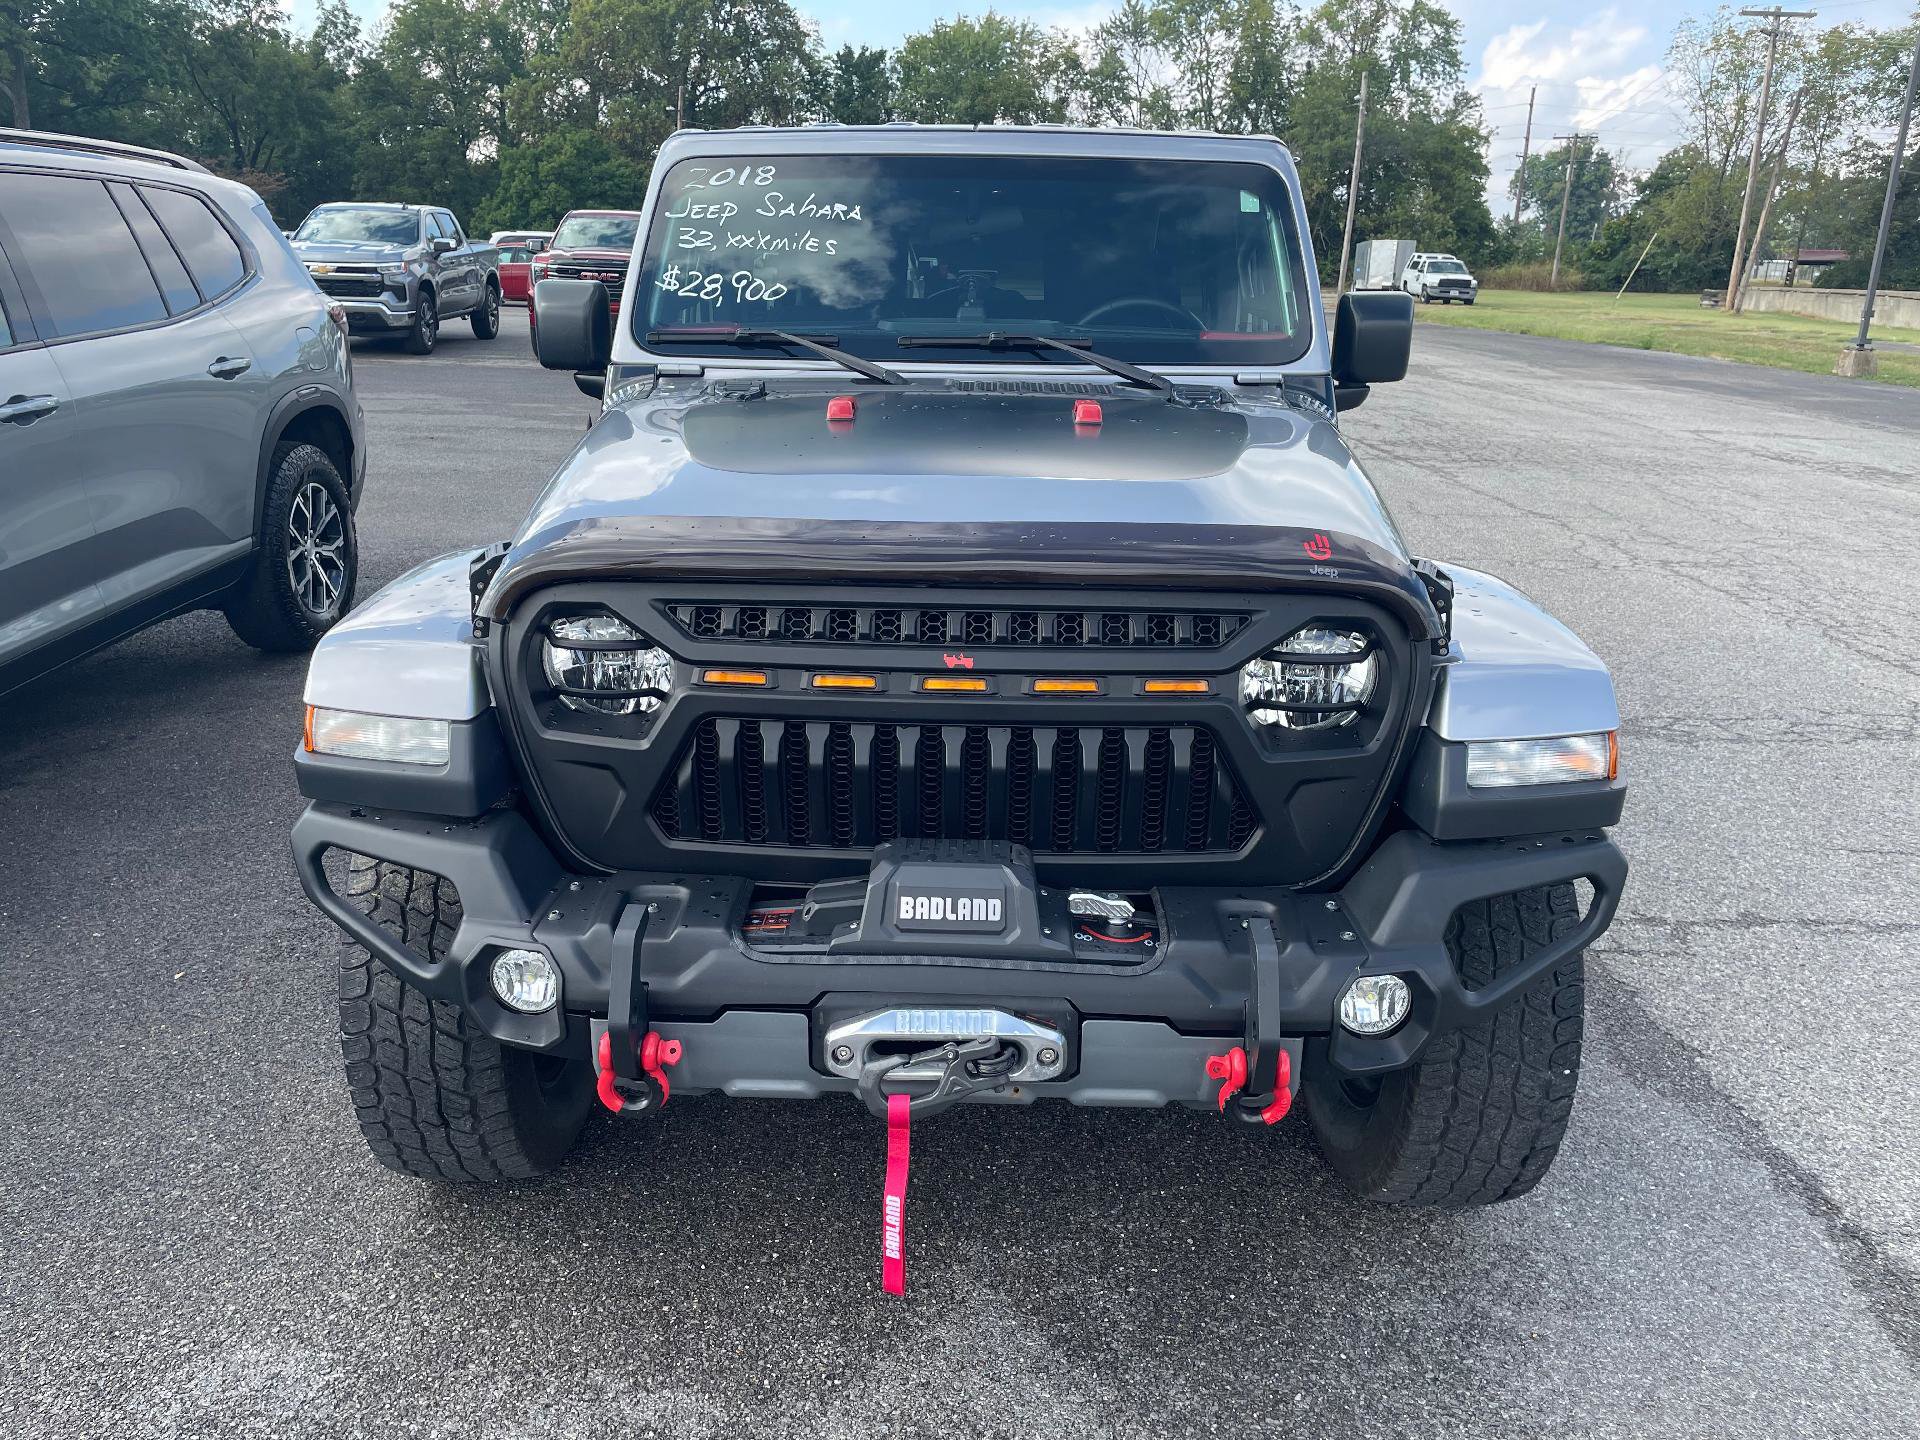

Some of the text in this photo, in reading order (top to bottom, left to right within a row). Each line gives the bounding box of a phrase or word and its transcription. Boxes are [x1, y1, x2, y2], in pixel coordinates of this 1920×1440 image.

[681, 165, 776, 190] 2018
[580, 271, 620, 281] GMC
[654, 263, 788, 308] $28,900
[1309, 564, 1339, 579] Jeep
[899, 896, 1002, 922] BADLAND
[895, 1010, 997, 1035] BADLAND
[885, 1194, 901, 1260] BADLAND
